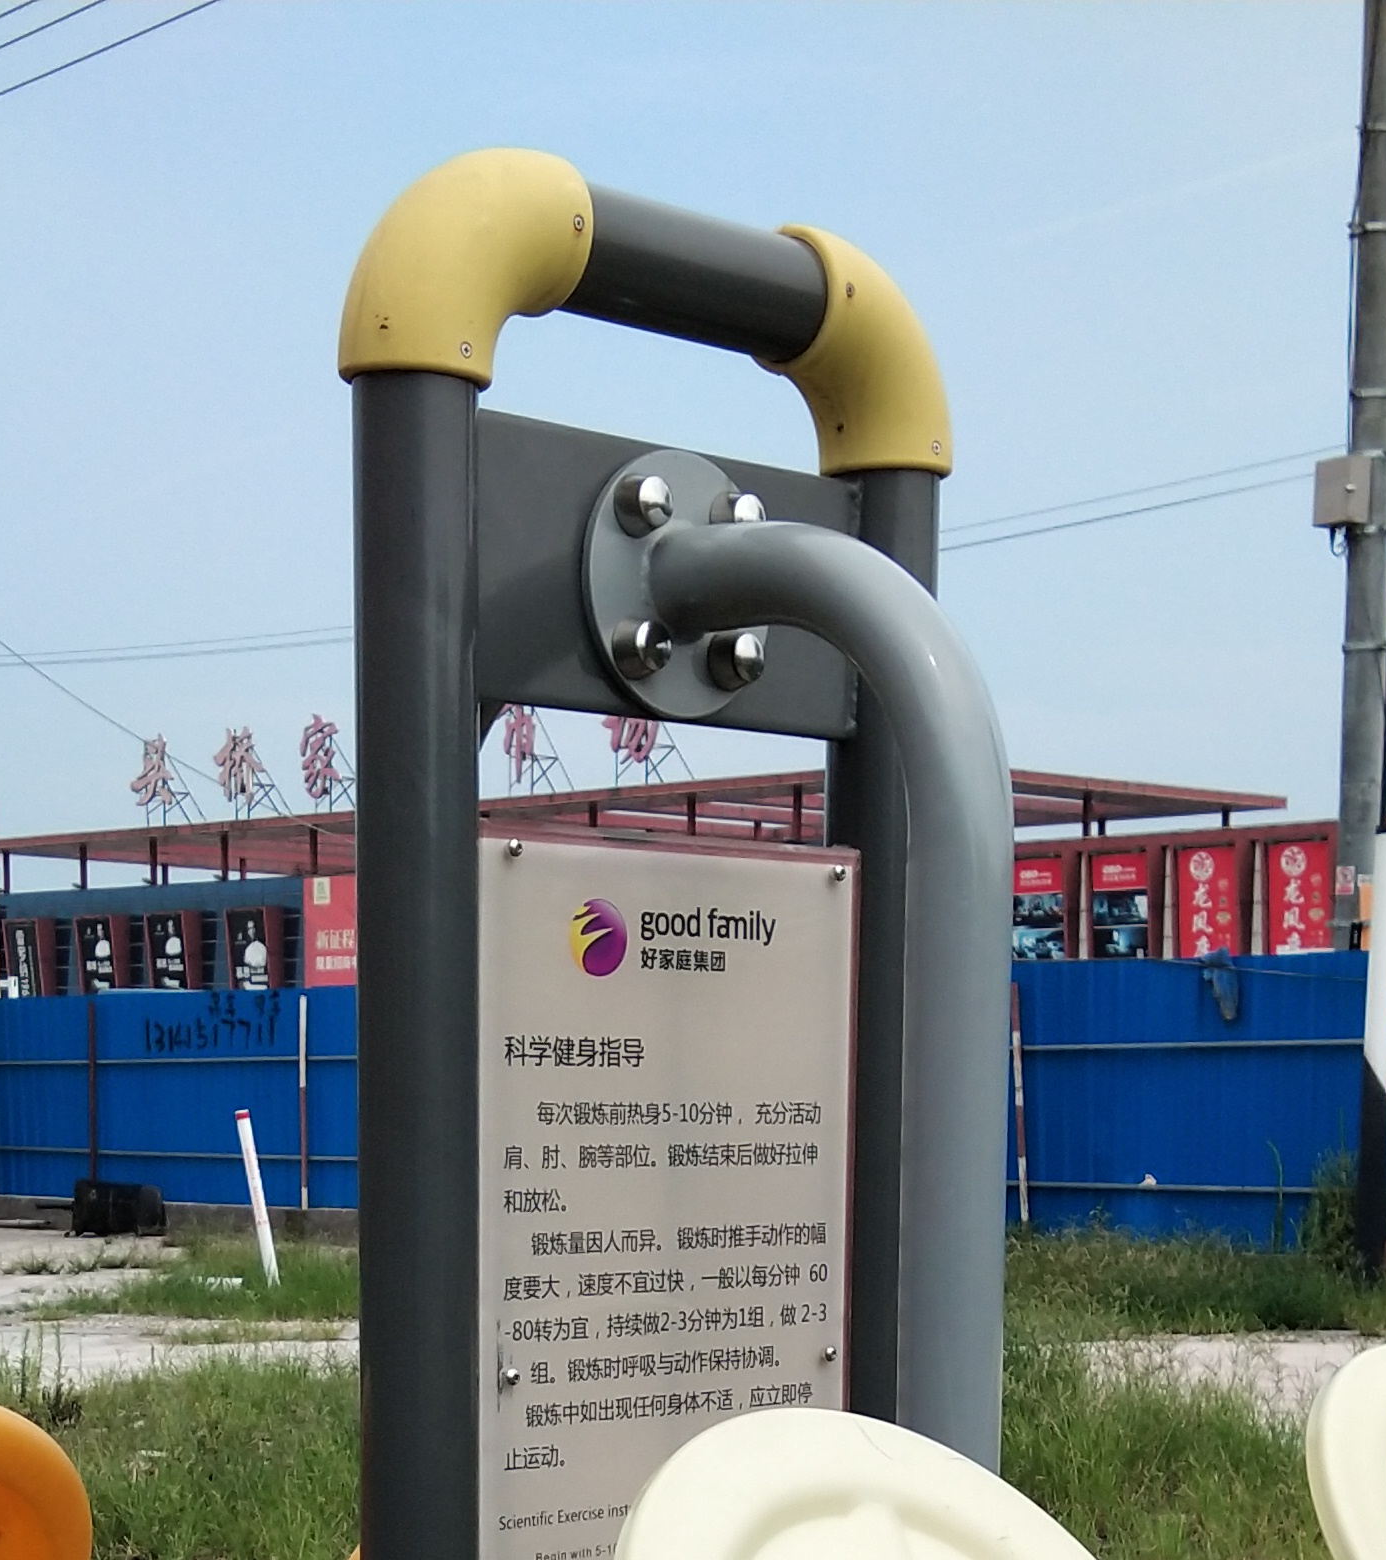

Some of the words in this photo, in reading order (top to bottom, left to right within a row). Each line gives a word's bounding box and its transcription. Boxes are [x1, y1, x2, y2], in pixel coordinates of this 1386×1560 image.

[641, 908, 701, 940] good
[708, 908, 776, 945] family
[641, 947, 726, 972] 好家庭集团
[504, 1036, 644, 1068] 科学健身指导
[503, 1188, 567, 1214] 和放松。
[503, 1444, 566, 1472] 止运动。
[499, 1510, 554, 1531] Scientific
[557, 1506, 604, 1524] Exercise
[570, 1548, 592, 1560] with
